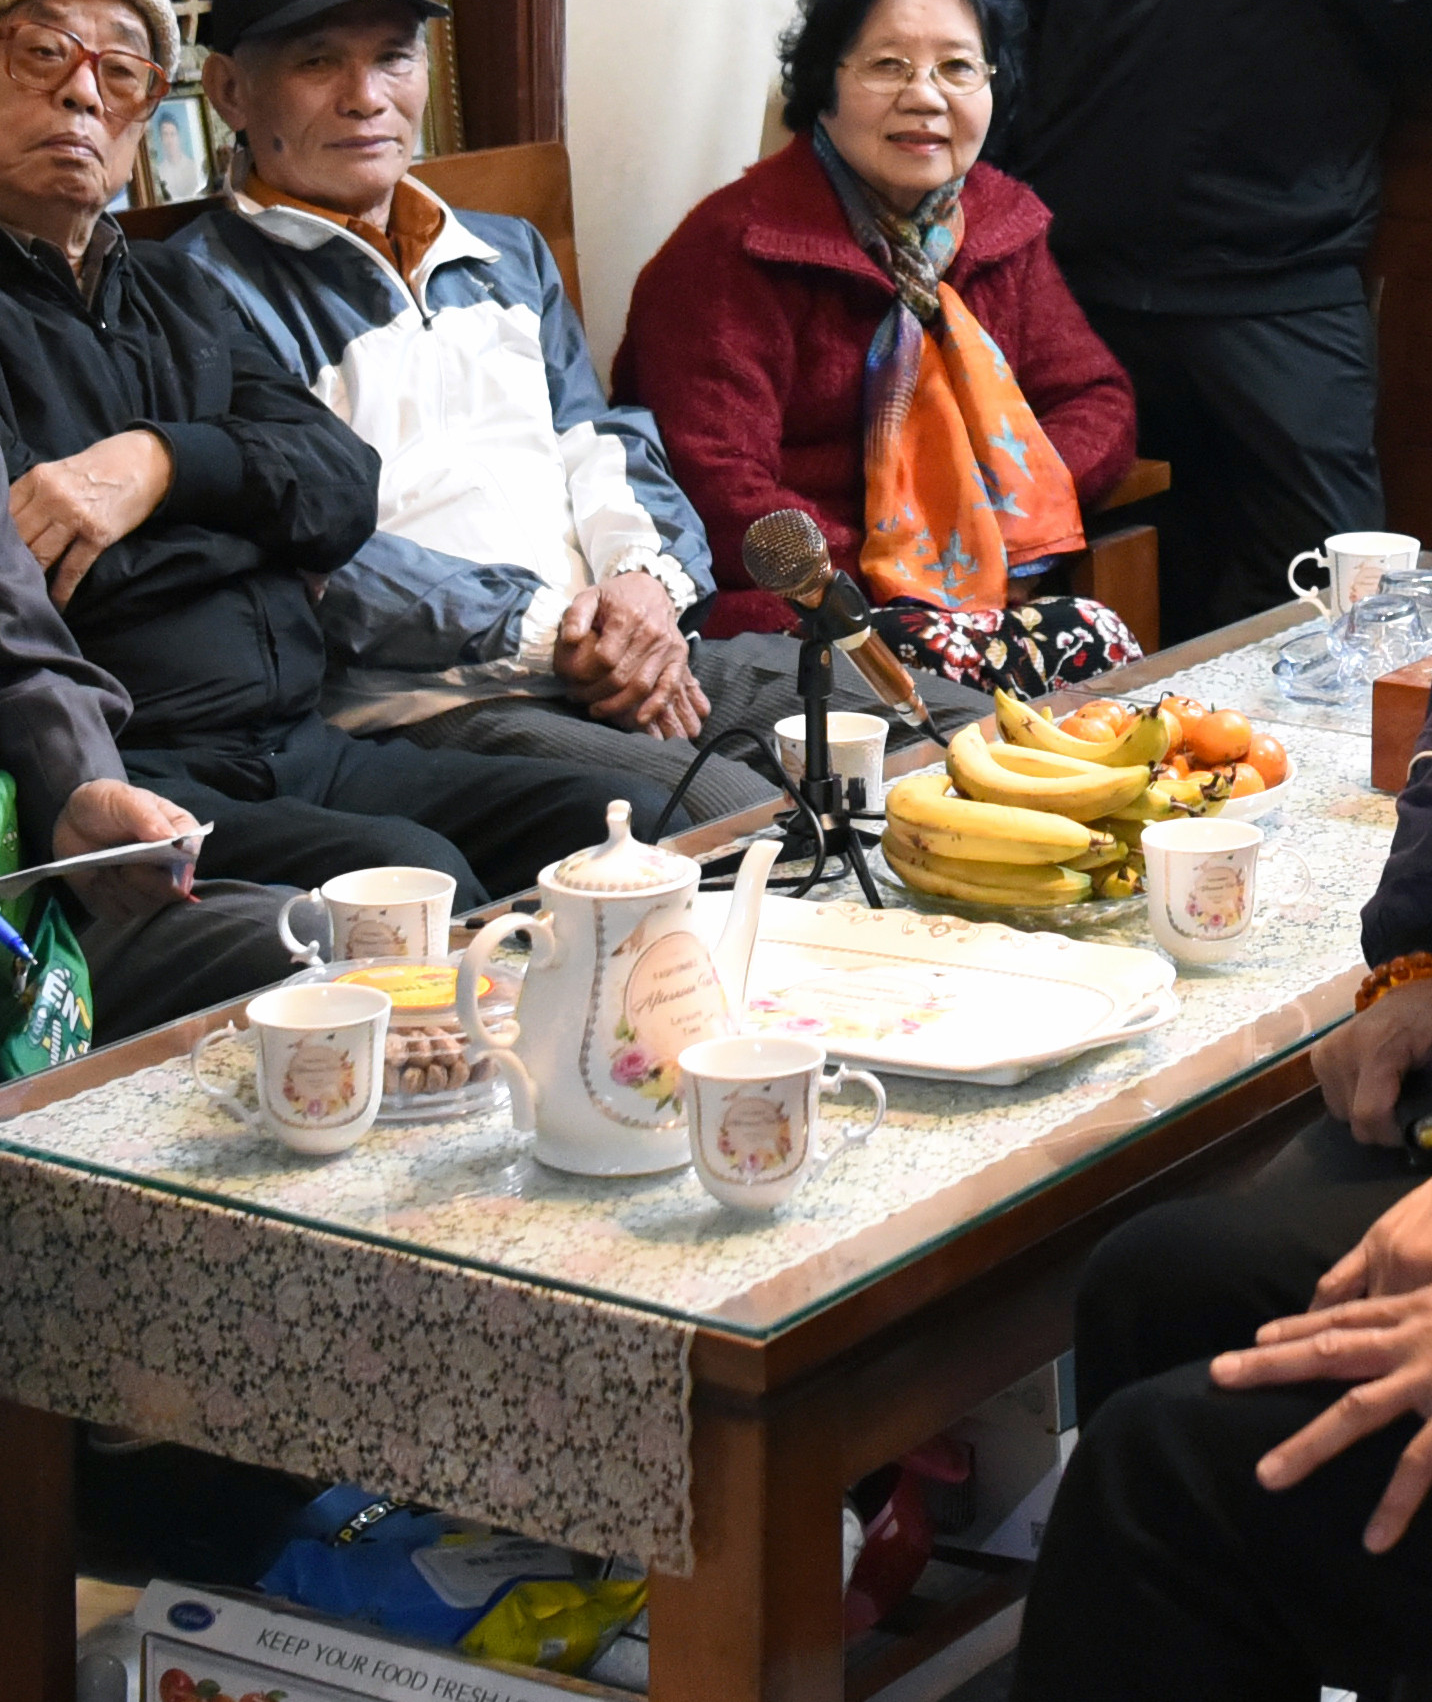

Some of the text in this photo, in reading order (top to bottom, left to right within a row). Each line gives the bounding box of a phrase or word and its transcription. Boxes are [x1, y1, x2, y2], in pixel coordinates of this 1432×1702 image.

[256, 1628, 310, 1657] KEEP
[314, 1643, 368, 1675] YOUR
[371, 1659, 429, 1692] FOOD
